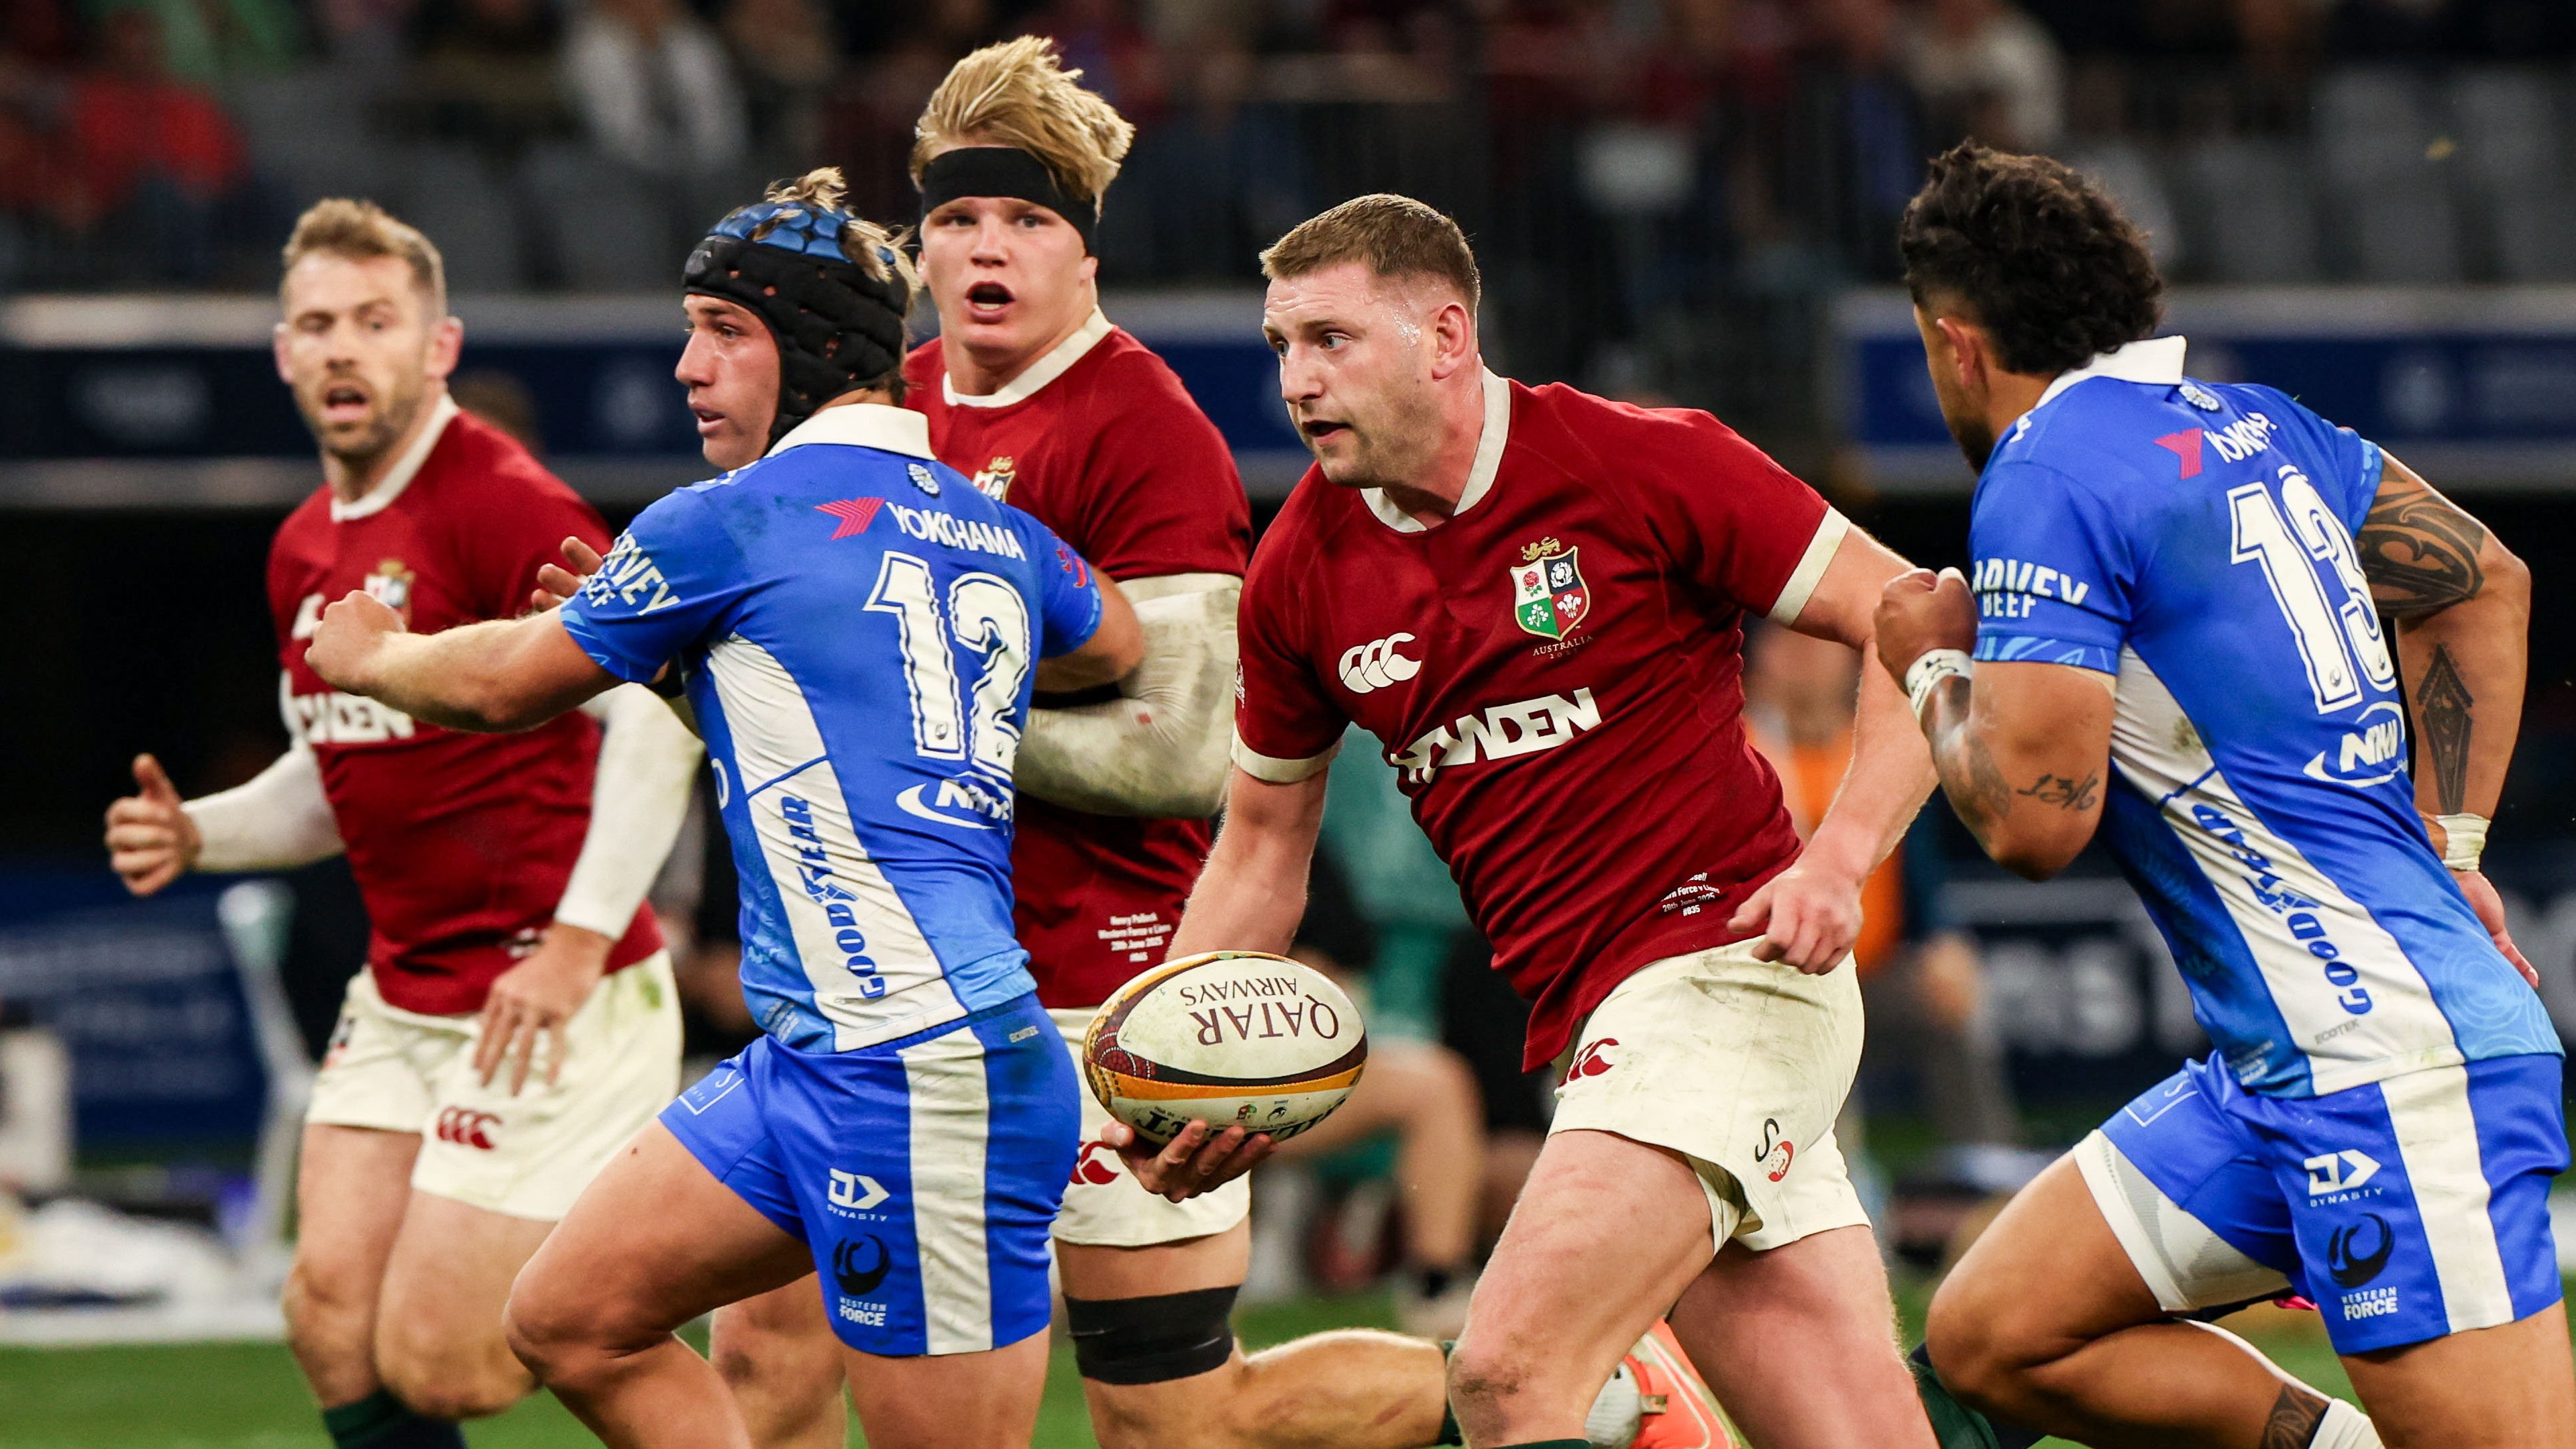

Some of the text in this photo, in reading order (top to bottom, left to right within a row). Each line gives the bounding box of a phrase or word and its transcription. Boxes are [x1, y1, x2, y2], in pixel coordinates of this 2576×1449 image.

[885, 501, 1027, 562] YOKOHAMA
[2226, 464, 2398, 715] 13
[1532, 635, 1593, 656] AUSTRALIA
[861, 550, 1030, 782] 12
[780, 796, 885, 999] GOODYEAR
[1677, 885, 1699, 896] Force
[1179, 977, 1297, 1006] AIRWAYS
[1188, 994, 1340, 1046] QATAR
[2310, 1187, 2383, 1208] DYNASTY
[826, 1203, 888, 1222] DYNASTY
[839, 1296, 888, 1312] WESTERN
[2341, 1286, 2397, 1305] WESTERN
[839, 1306, 886, 1327] FORCE
[2343, 1297, 2398, 1322] FORCE
